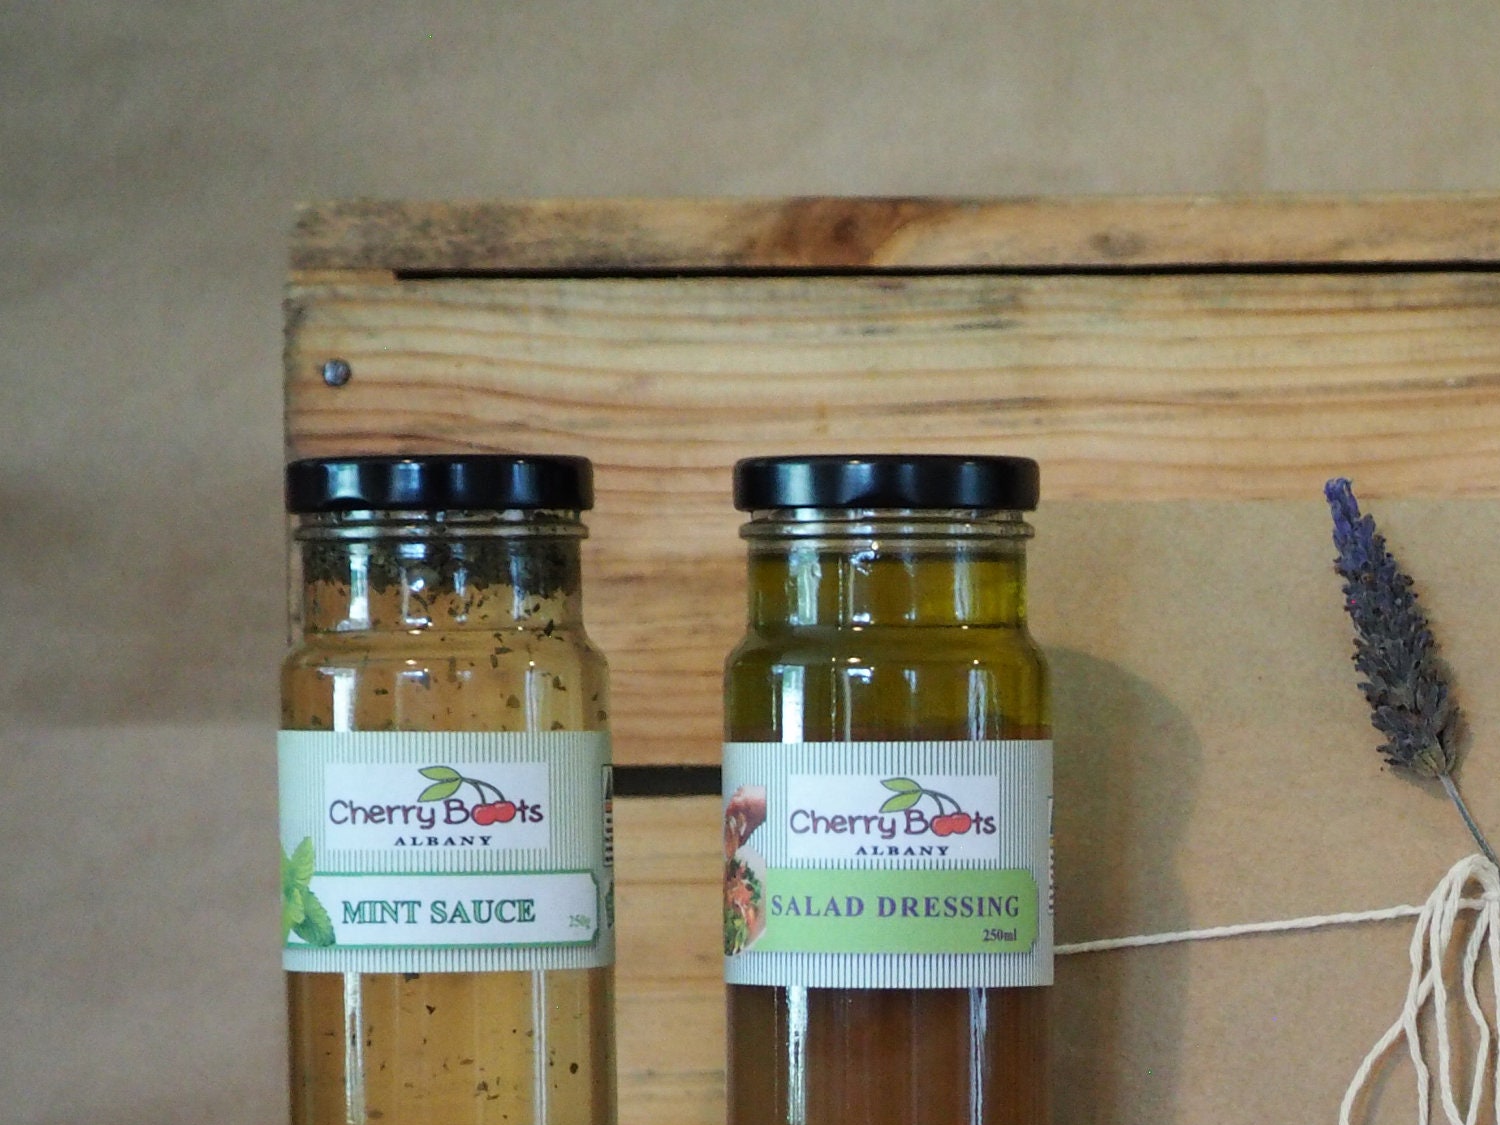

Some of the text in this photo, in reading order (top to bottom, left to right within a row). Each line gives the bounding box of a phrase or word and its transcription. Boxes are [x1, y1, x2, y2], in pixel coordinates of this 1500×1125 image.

[329, 799, 544, 829] Cherry Boots
[789, 809, 997, 839] Cherry Boots
[394, 835, 493, 847] ALBANY
[854, 845, 950, 857] ALBANY
[341, 898, 536, 925] MINT SAUCE
[770, 894, 1020, 919] SALAD DRESSING
[982, 928, 1018, 943] 250ml
